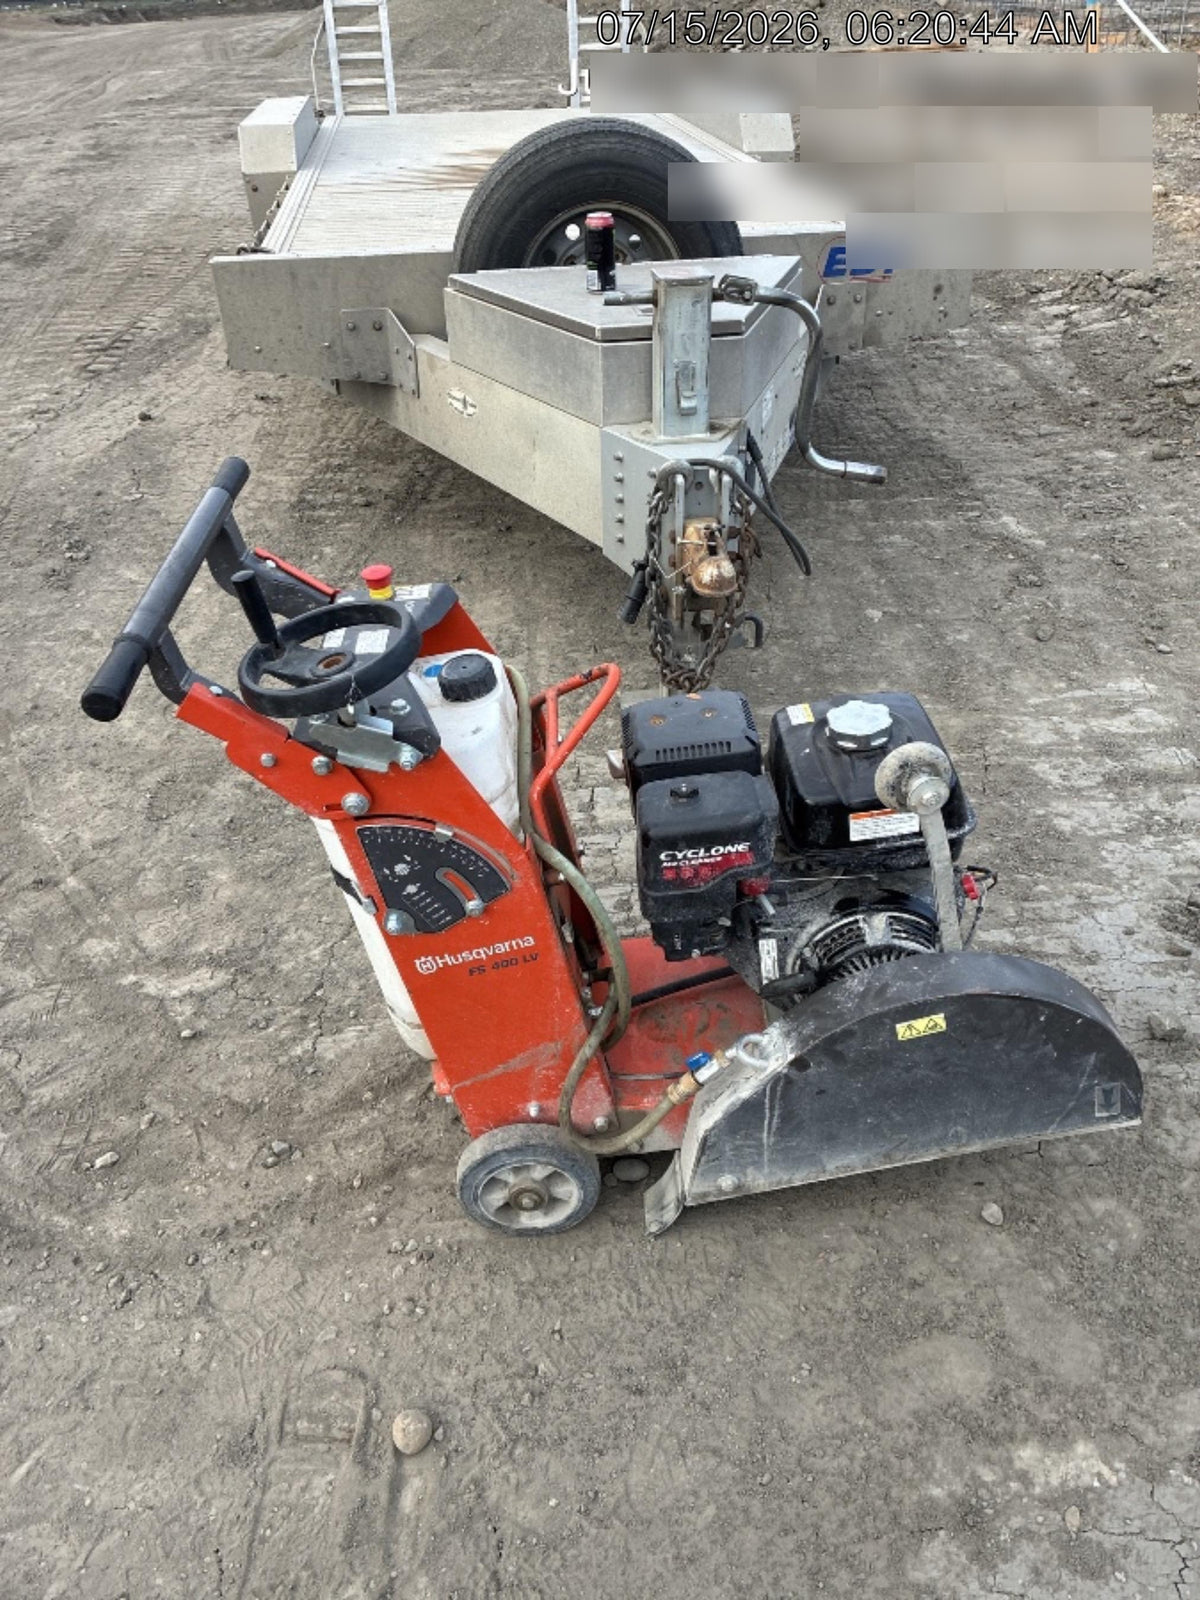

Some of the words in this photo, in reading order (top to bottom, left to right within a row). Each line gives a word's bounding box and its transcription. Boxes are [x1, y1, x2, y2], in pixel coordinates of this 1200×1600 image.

[659, 842, 751, 862] CYCLONE
[435, 935, 535, 968] Husqvarna
[468, 965, 487, 977] FS
[491, 956, 519, 971] 400
[522, 952, 539, 964] LV
